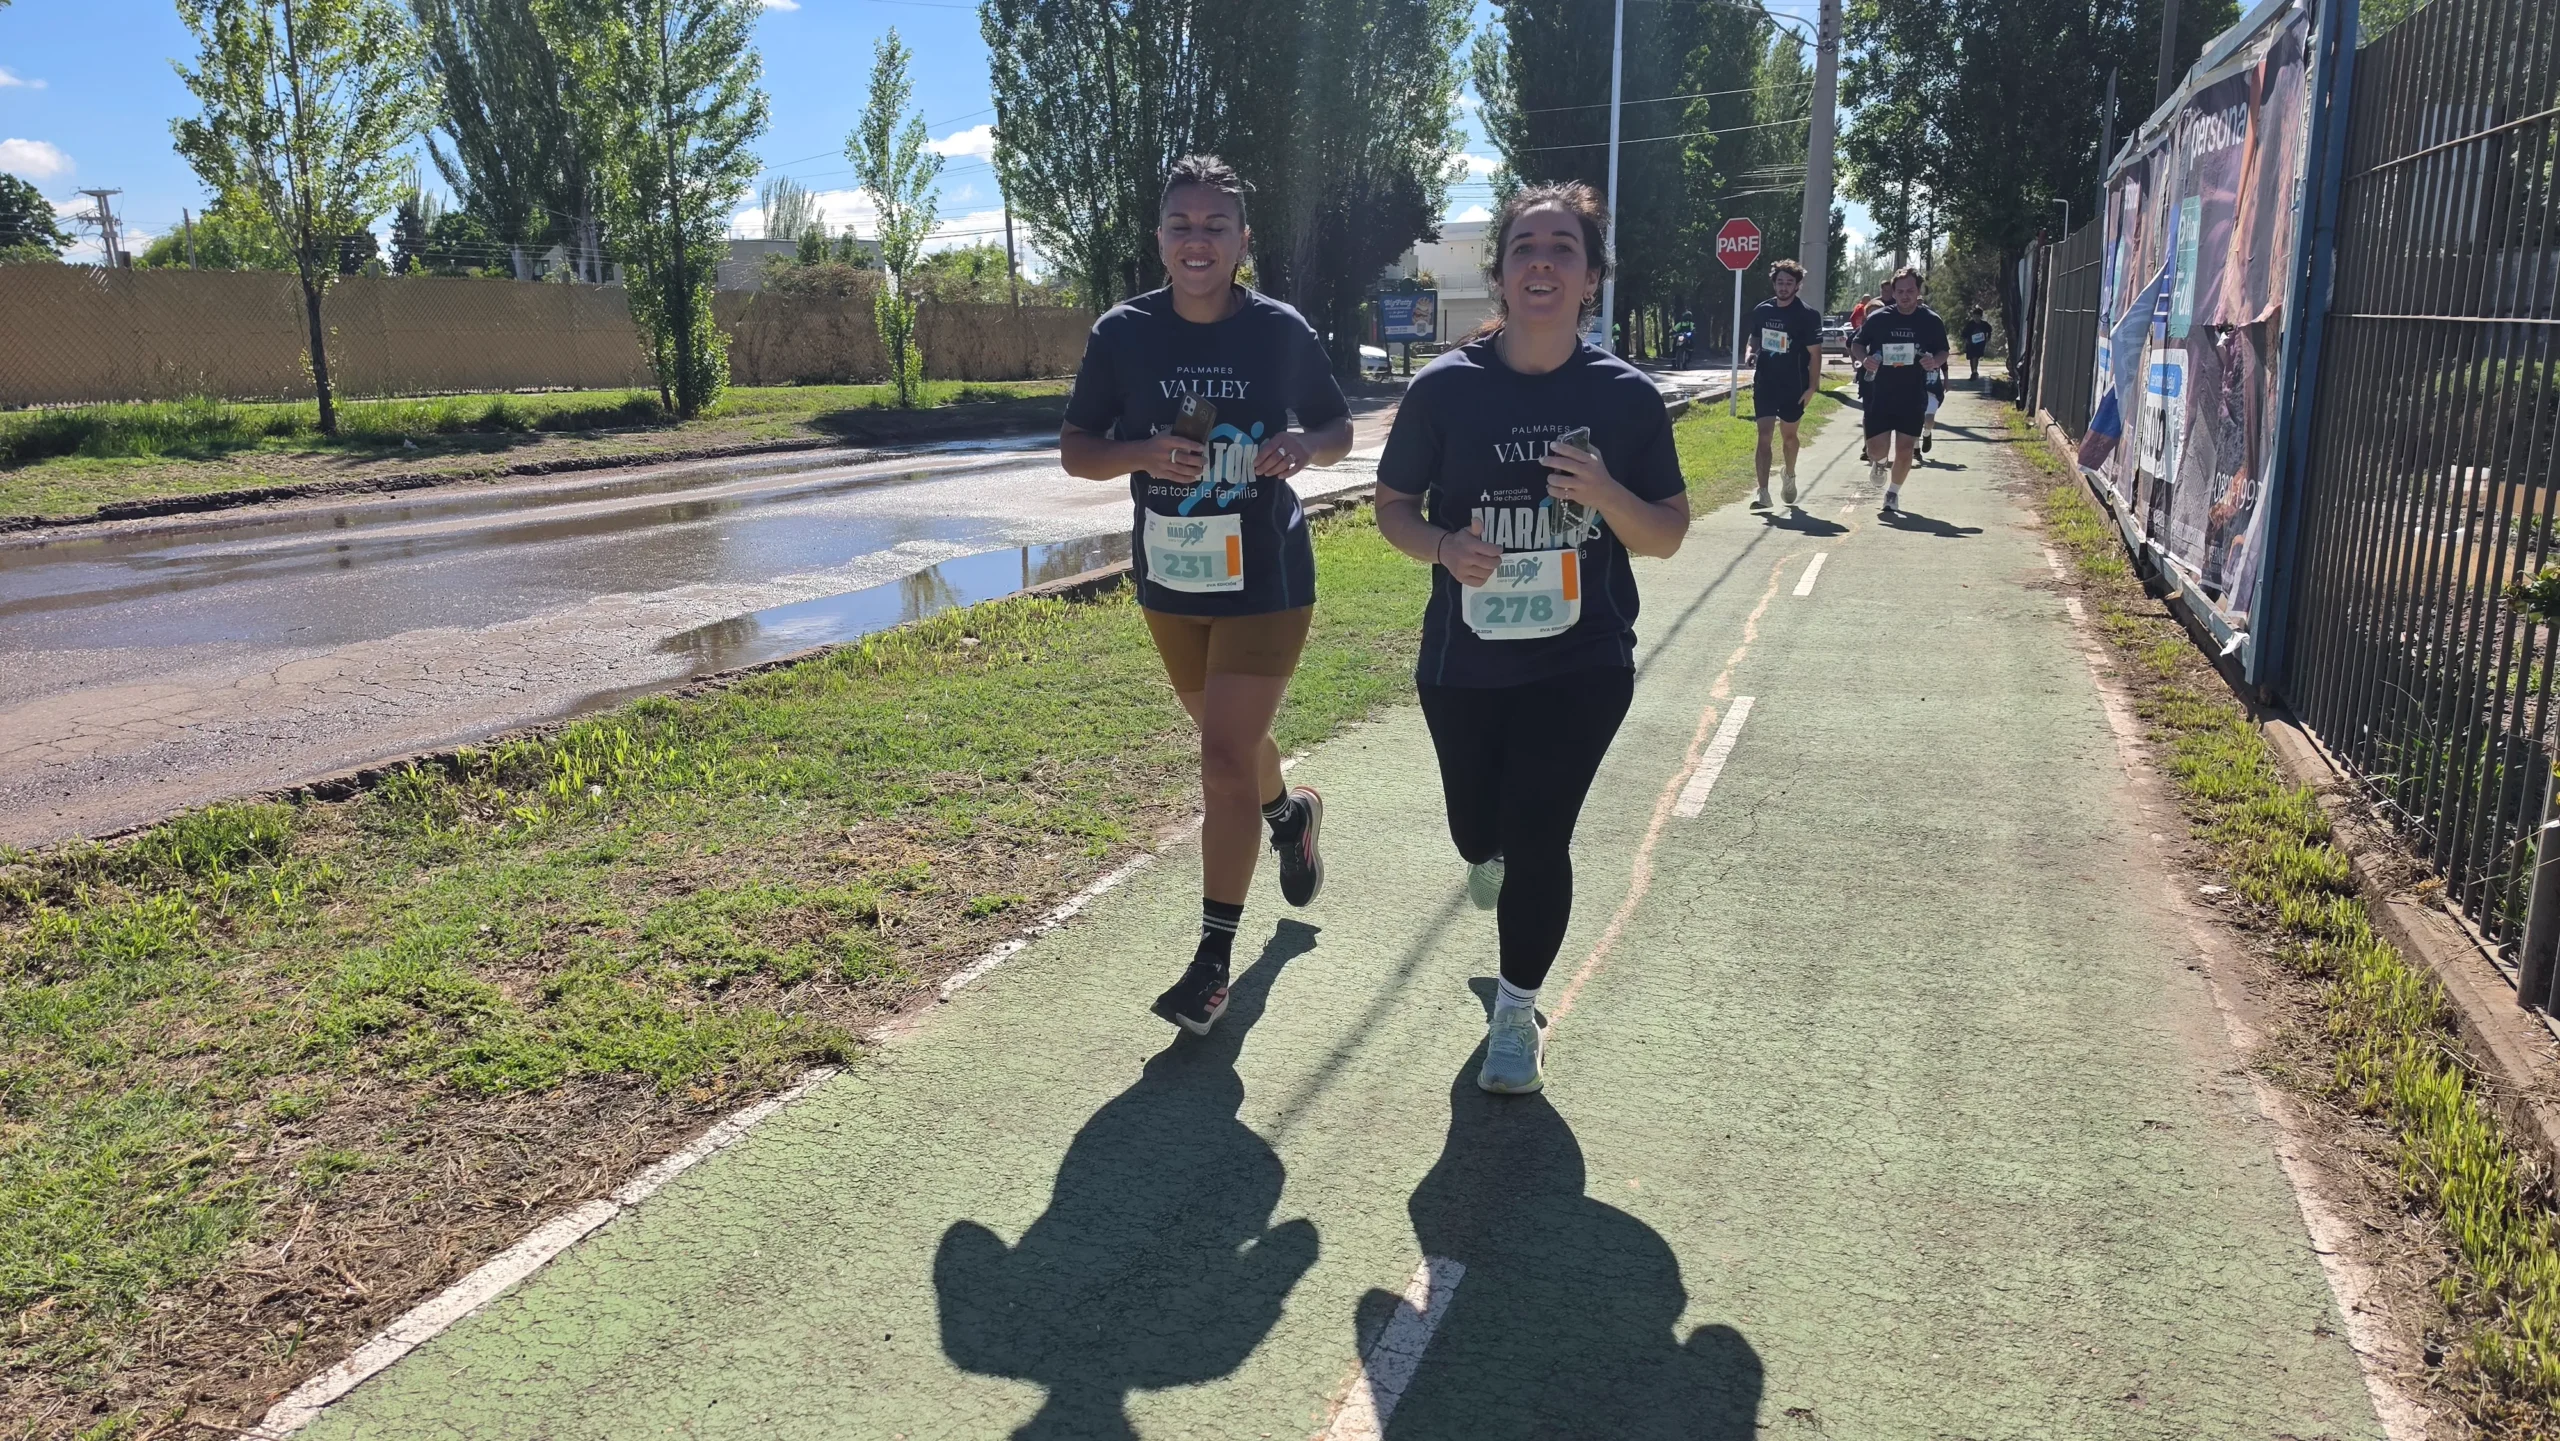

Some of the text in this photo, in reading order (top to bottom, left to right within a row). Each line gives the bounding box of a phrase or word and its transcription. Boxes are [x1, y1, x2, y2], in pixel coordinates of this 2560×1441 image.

[2190, 102, 2248, 171] persona
[1718, 235, 1760, 254] PARE
[1890, 330, 1915, 338] VALLEY
[1176, 366, 1234, 375] PALMARES
[1159, 379, 1251, 399] VALLEY
[1511, 424, 1571, 435] PALMARES
[1492, 439, 1552, 464] VALL
[1147, 484, 1259, 500] para toda la familia
[1493, 486, 1529, 497] parroquia
[1493, 493, 1532, 503] de chacras
[1163, 553, 1213, 579] 231
[1484, 594, 1554, 624] 278
